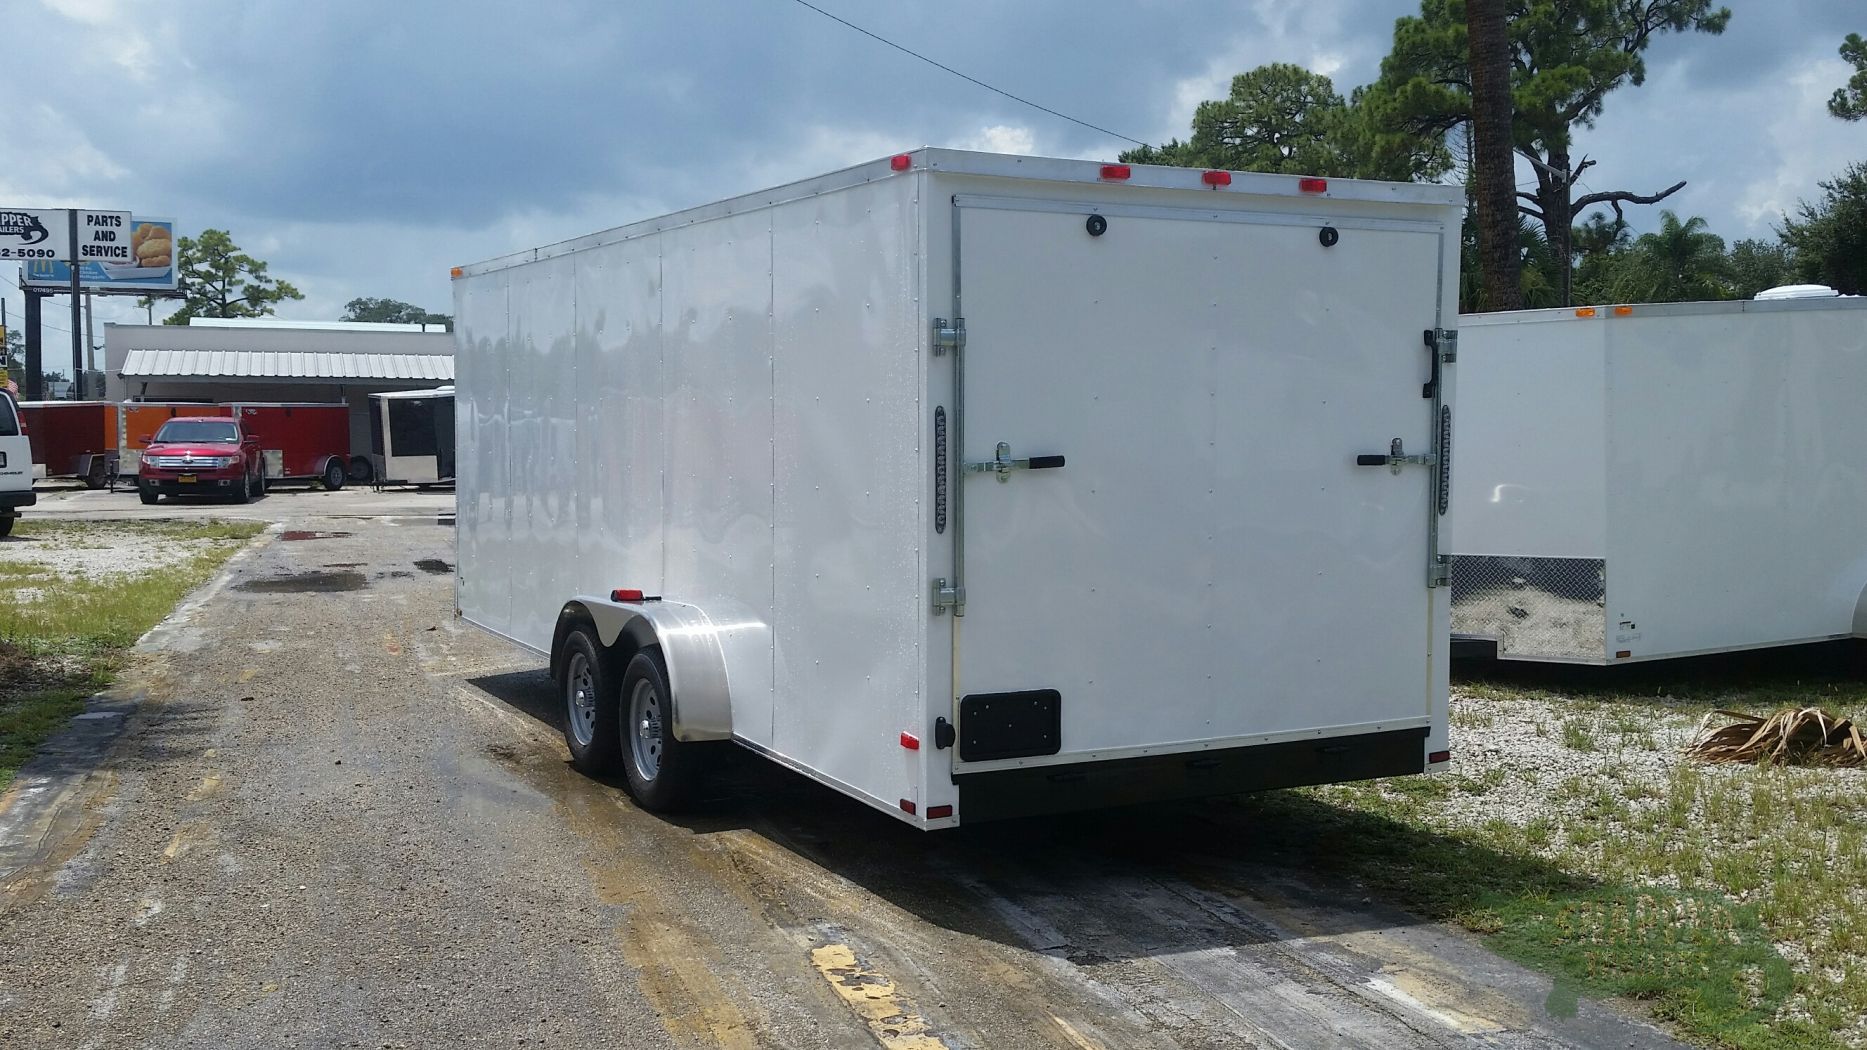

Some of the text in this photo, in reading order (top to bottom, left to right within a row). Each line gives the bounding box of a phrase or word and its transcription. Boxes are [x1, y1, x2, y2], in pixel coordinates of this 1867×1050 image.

[86, 214, 122, 227] PARTS
[93, 230, 117, 242] AND
[0, 248, 56, 258] 2-5090
[81, 244, 128, 258] SERVICE
